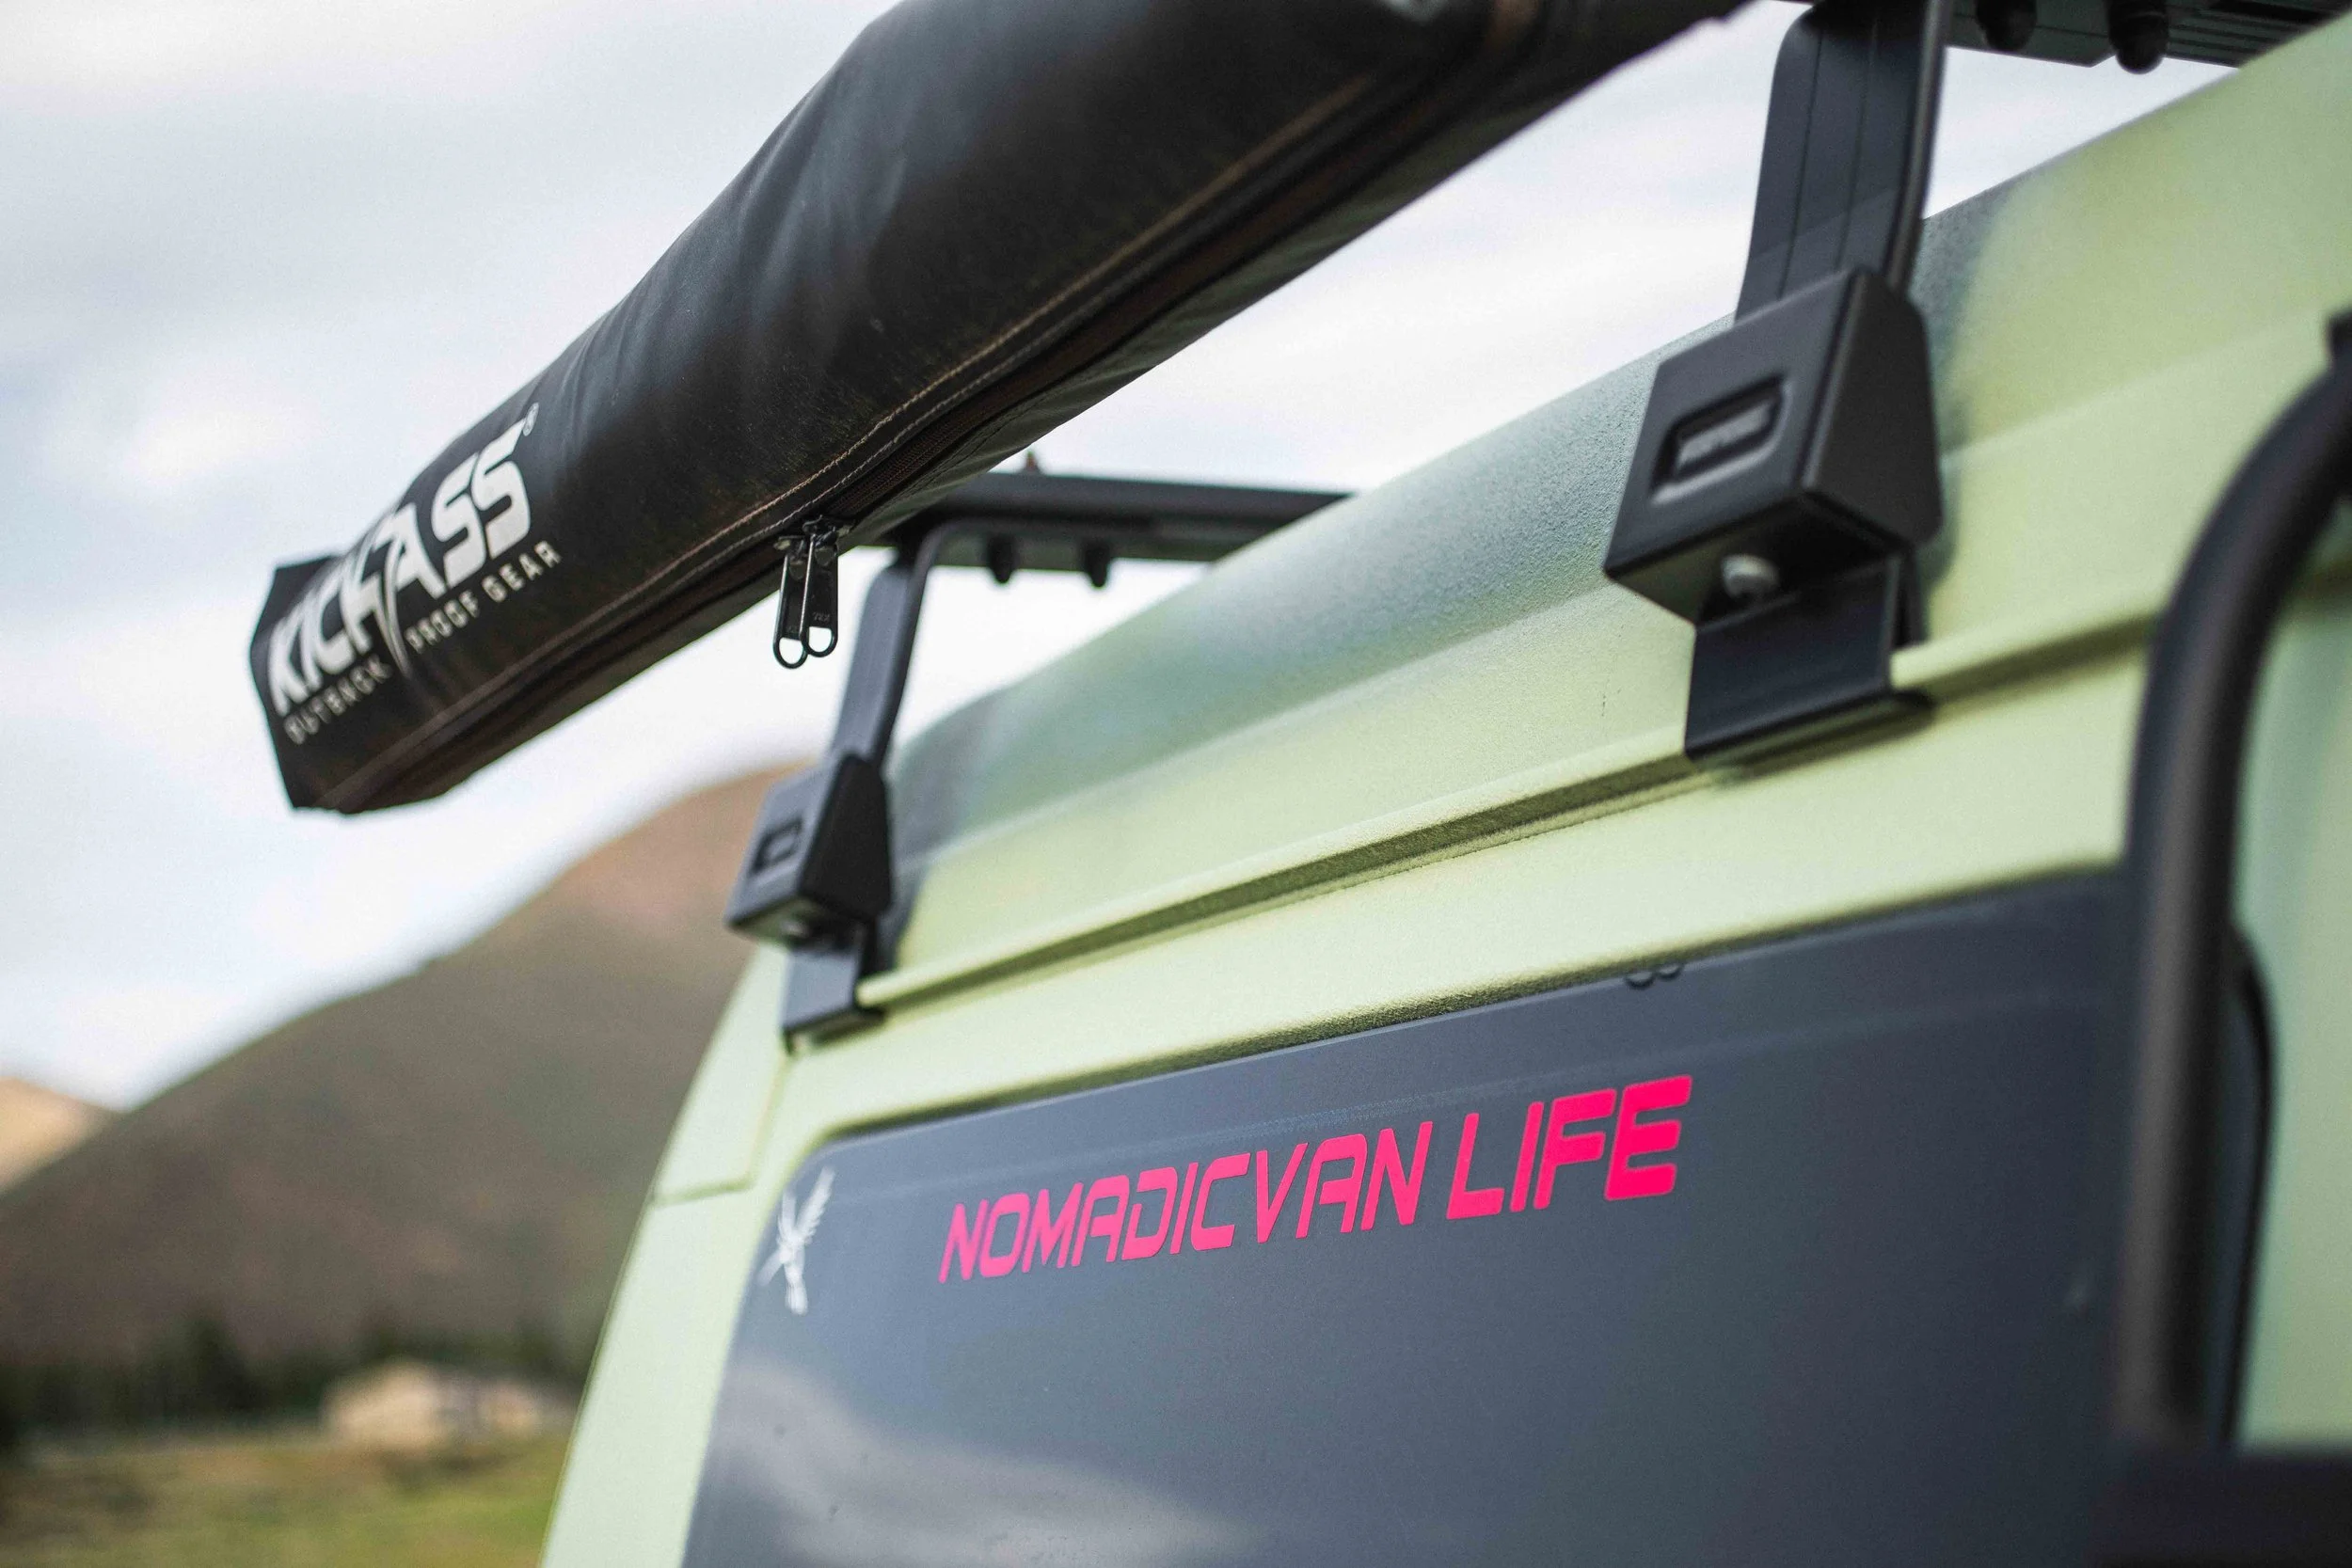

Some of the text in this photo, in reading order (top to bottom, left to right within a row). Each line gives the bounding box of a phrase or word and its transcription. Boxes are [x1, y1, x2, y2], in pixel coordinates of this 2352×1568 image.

[268, 418, 531, 717] KICKASS
[283, 540, 562, 745] OUTBACK PROOF GEAR
[1446, 1074, 1692, 1220] LIFE
